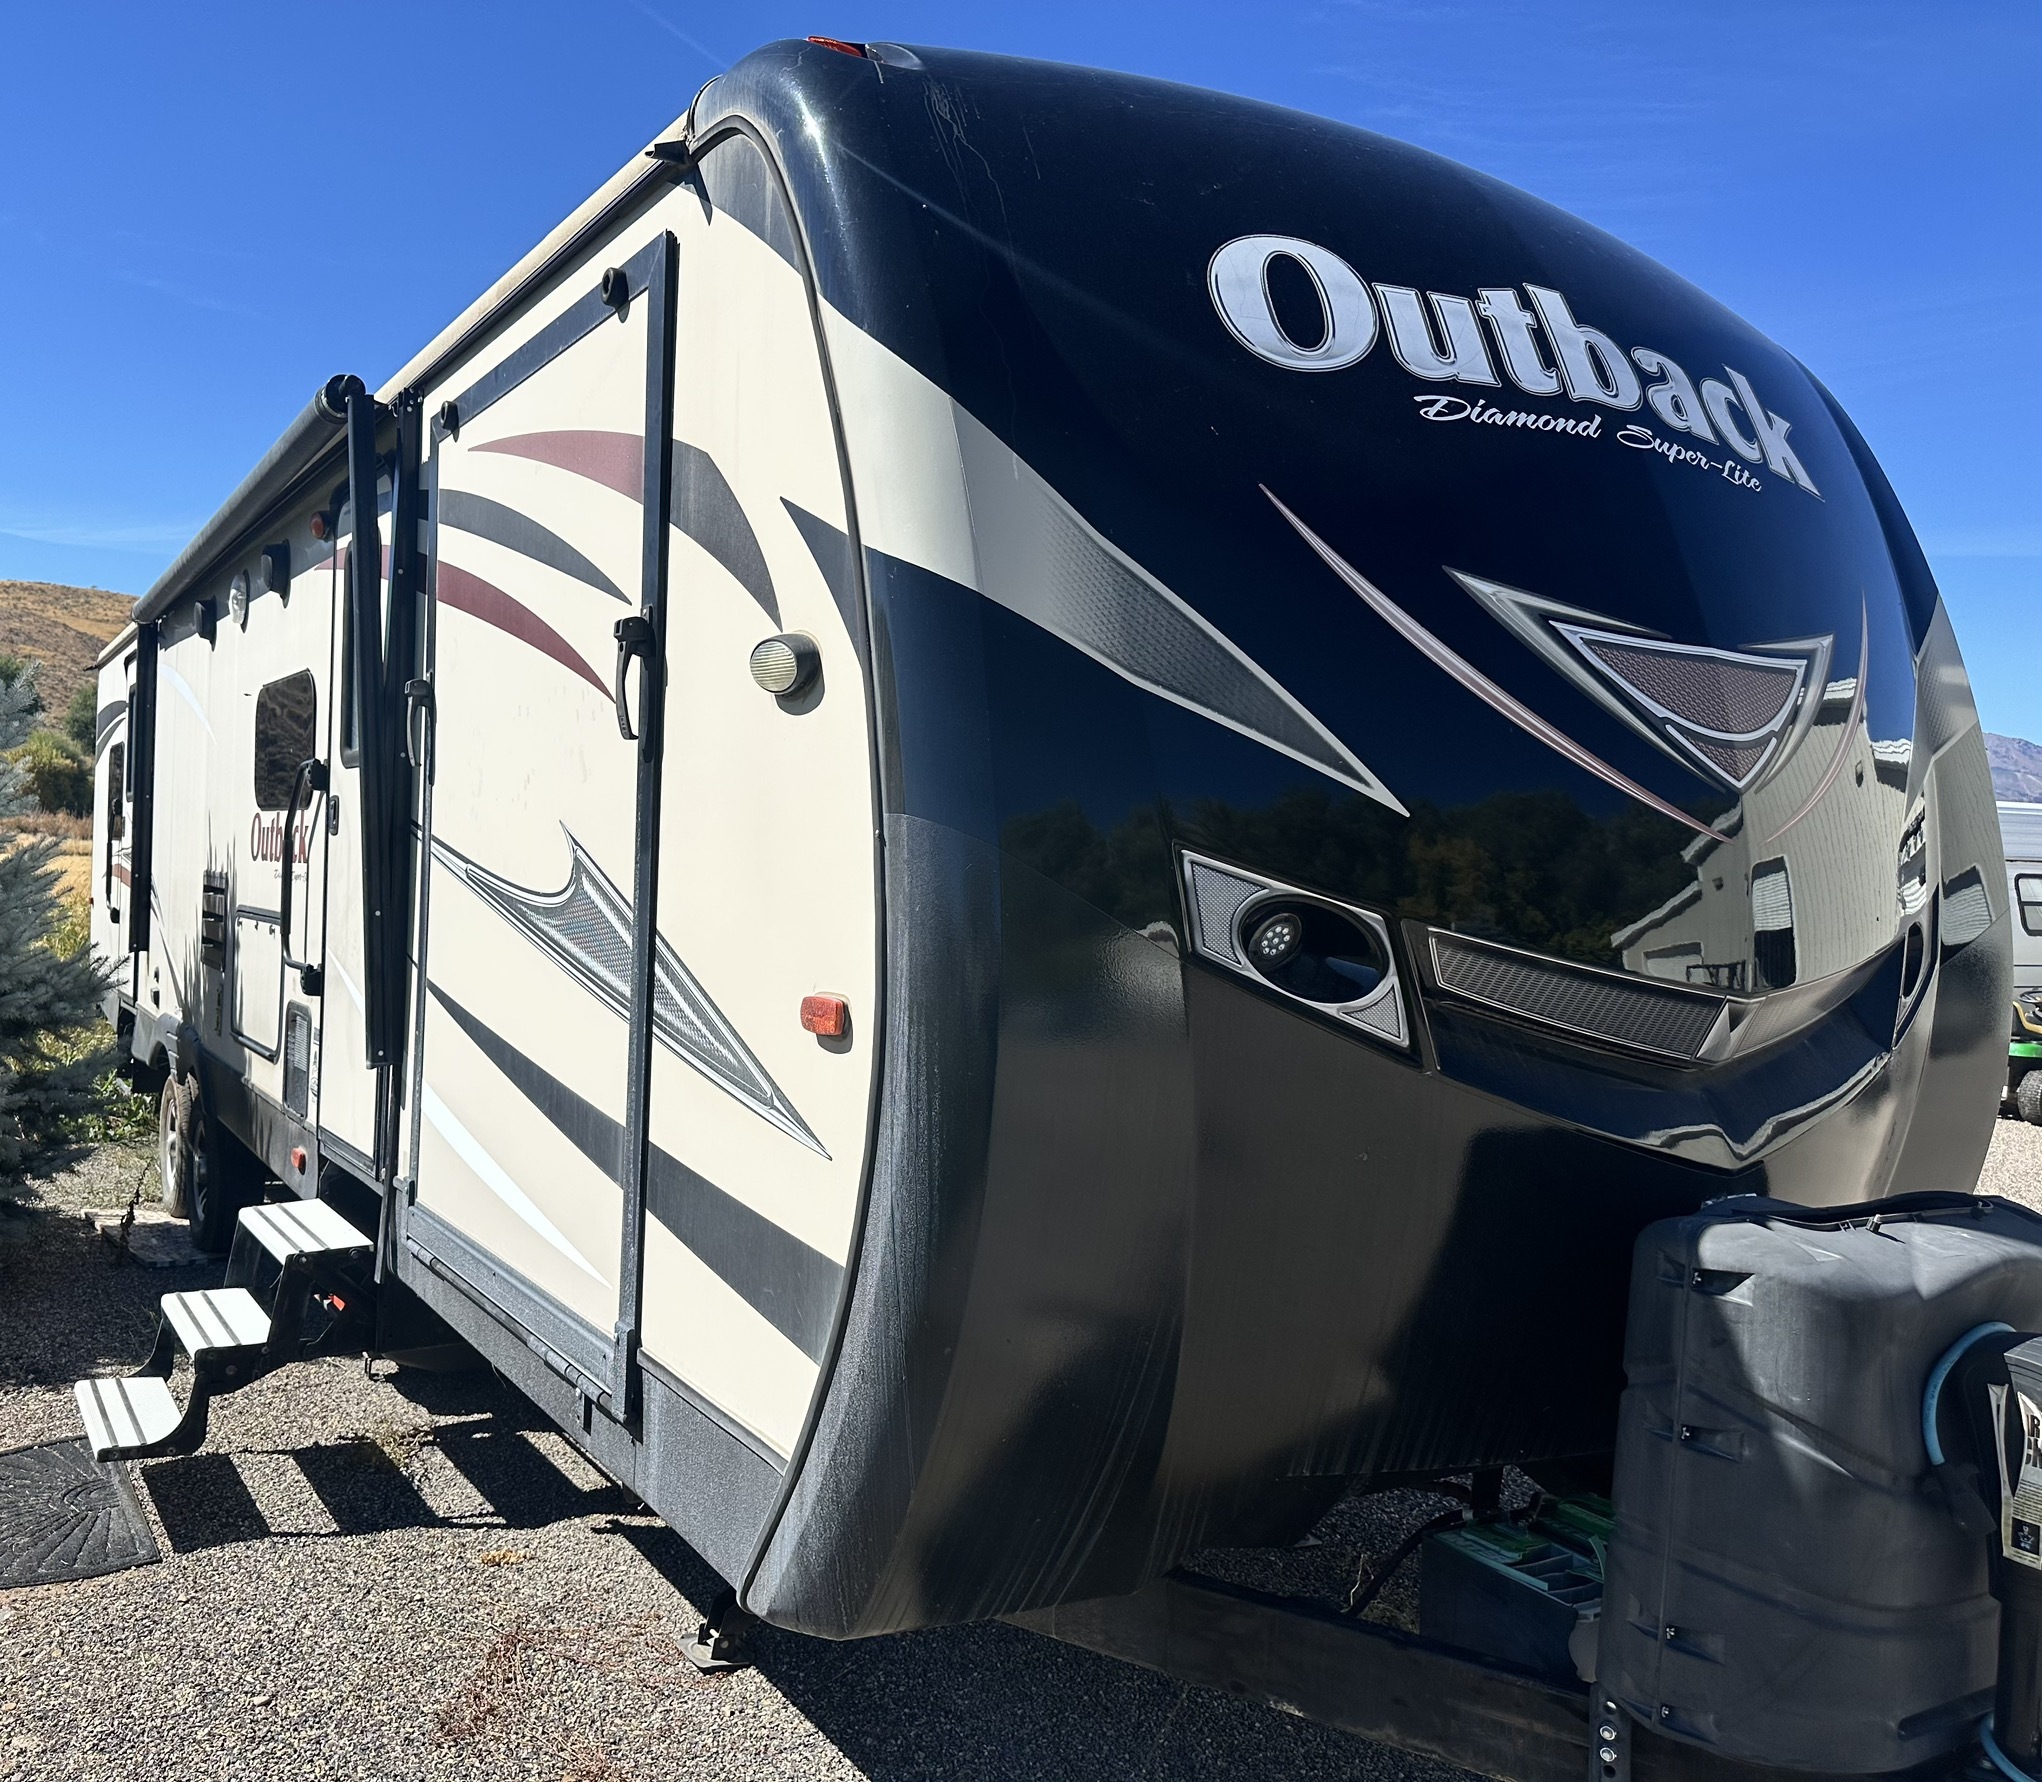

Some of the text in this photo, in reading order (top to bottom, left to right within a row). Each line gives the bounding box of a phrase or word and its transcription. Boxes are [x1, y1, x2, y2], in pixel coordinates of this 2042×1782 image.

[1207, 234, 1825, 502] Outback
[1413, 395, 1762, 492] Diamond Super-Lite
[251, 810, 309, 863] Outbck
